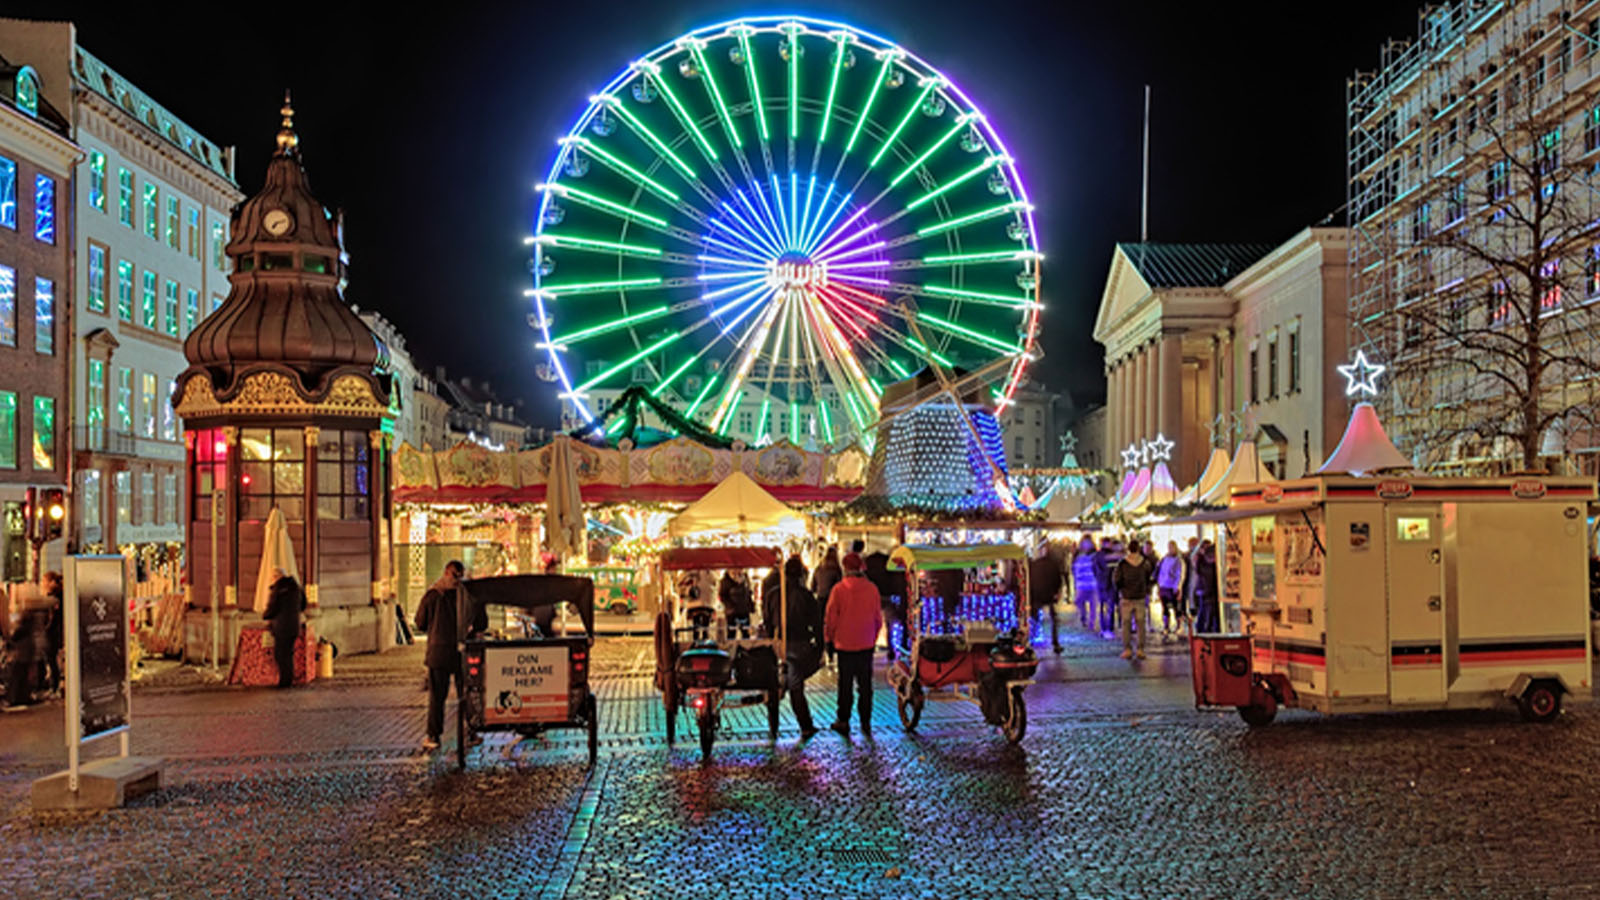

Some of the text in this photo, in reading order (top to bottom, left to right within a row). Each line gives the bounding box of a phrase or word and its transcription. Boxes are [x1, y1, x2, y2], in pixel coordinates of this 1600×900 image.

[517, 654, 539, 665] DIN
[501, 665, 553, 677] REKLAME
[515, 677, 543, 688] HER?
